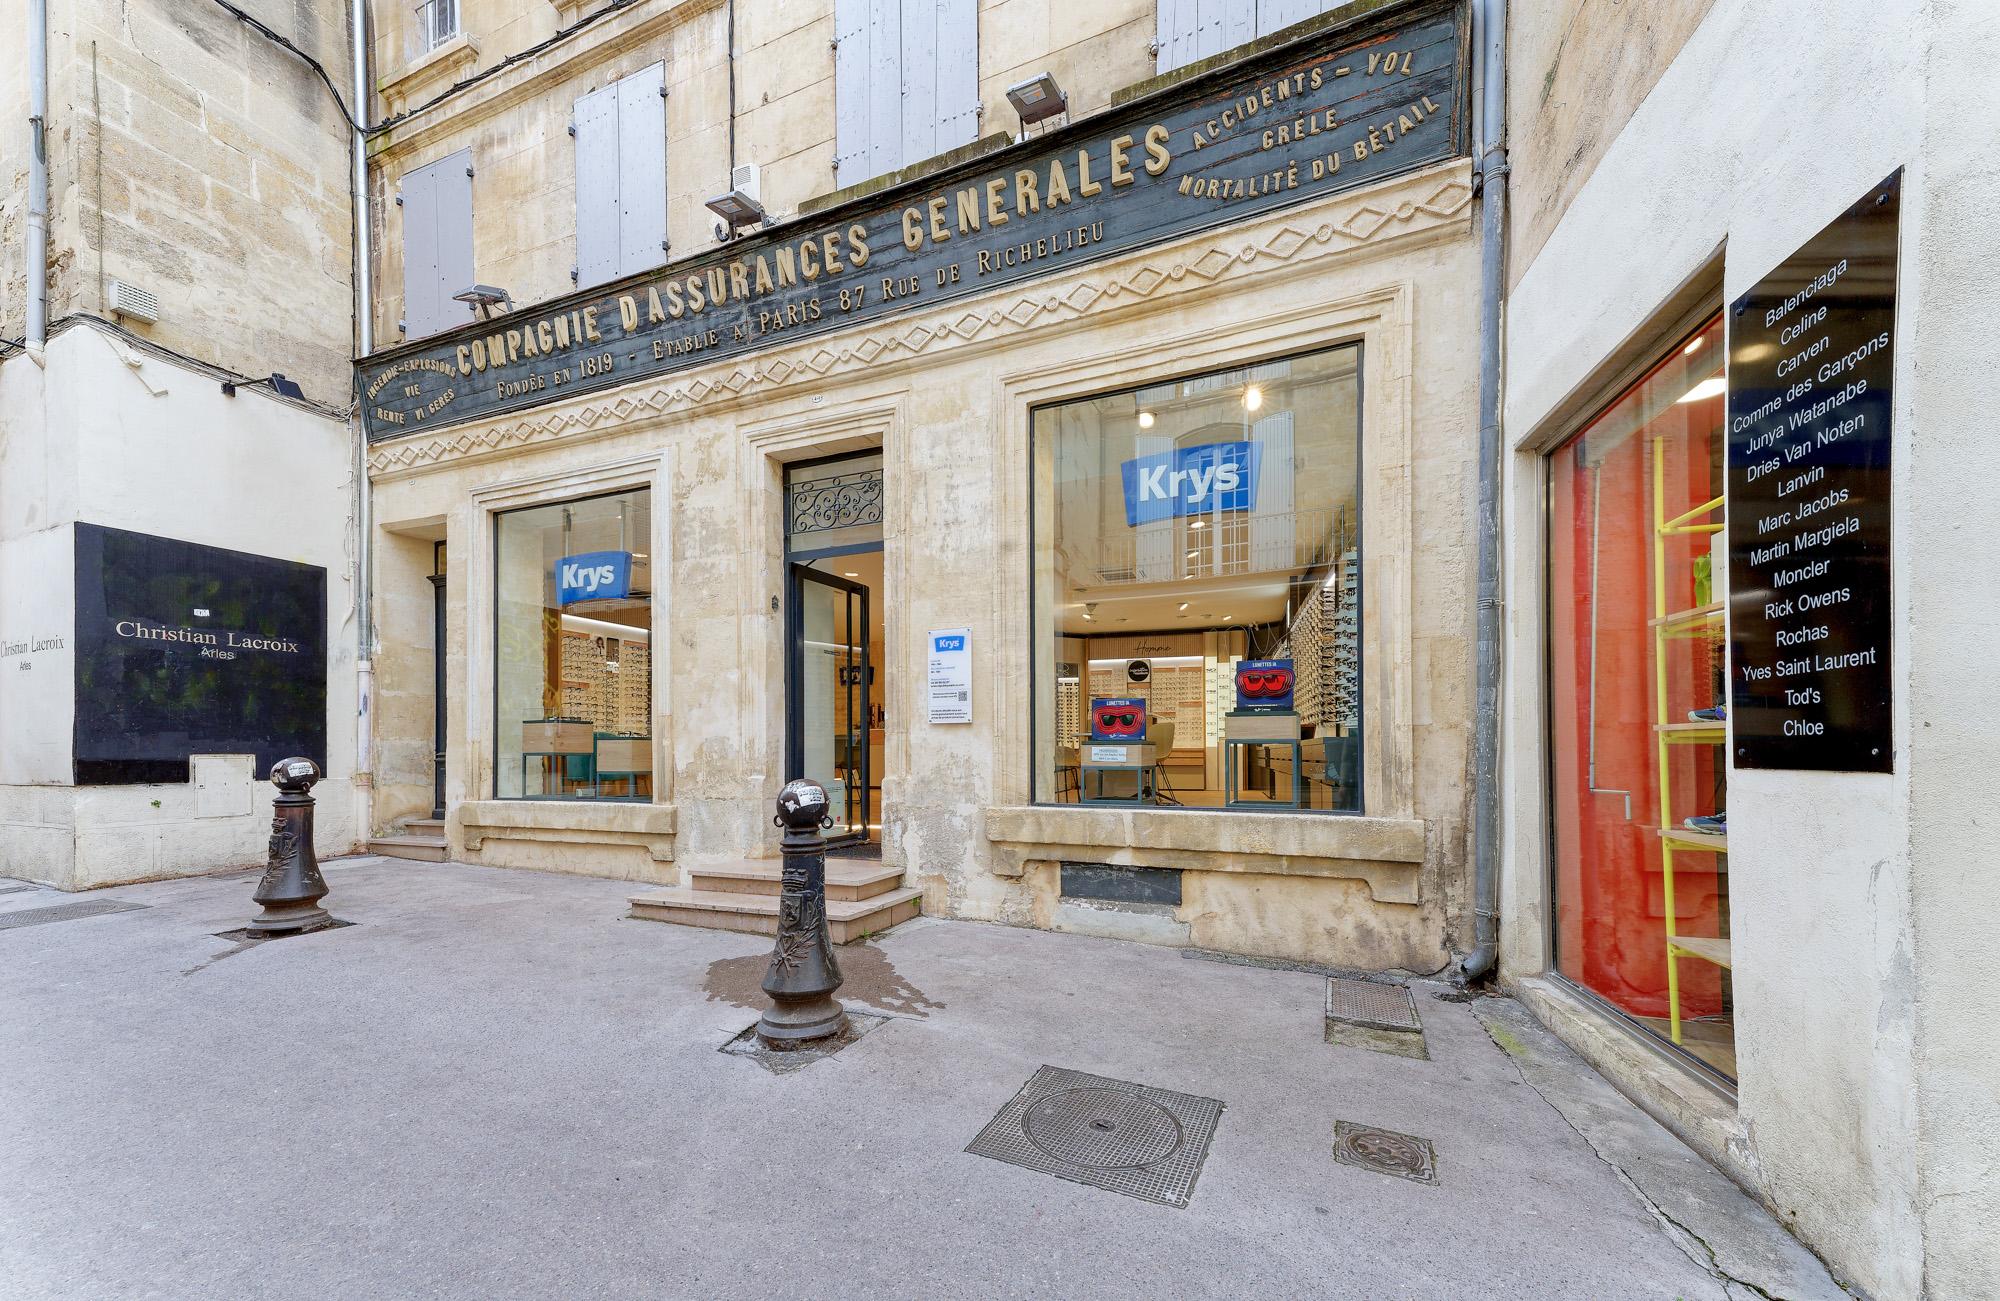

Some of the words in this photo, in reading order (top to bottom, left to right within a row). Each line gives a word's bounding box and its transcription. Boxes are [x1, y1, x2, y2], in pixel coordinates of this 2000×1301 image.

[1193, 67, 1323, 150] ACCIDENTS
[1367, 52, 1413, 76] VOL
[1312, 152, 1341, 181] DU
[456, 305, 602, 377] COMPAGNIE
[902, 124, 1171, 252] GENERALES
[554, 368, 571, 385] EN
[580, 353, 613, 379] 1819
[760, 298, 821, 334] PARIS
[840, 285, 865, 311] 87
[881, 275, 920, 301] RUE
[936, 264, 961, 286] DE
[977, 221, 1105, 275] RICHELIEU
[1765, 259, 1848, 328] Balenciaga
[1780, 305, 1828, 346] Celine
[1777, 335, 1829, 378] Carven
[404, 384, 420, 398] VIE
[1733, 397, 1782, 434] Comme
[1787, 377, 1812, 403] des
[1818, 331, 1889, 384] Garçons
[377, 407, 405, 425] RENTE
[1746, 425, 1784, 455] Junya
[1789, 378, 1867, 433] Watanabe
[1747, 459, 1780, 483] Dries
[1784, 441, 1812, 463] Van
[1817, 412, 1865, 449] Noten
[1139, 464, 1240, 504] Krys
[1778, 465, 1825, 498] Lanvin
[1758, 514, 1791, 535] Marc
[1795, 487, 1849, 520] Jacobs
[1750, 543, 1790, 567] Martin
[1795, 516, 1860, 551] Margiela
[562, 563, 615, 592] Krys
[1774, 558, 1830, 588] Moncler
[1765, 599, 1794, 620] Rick
[1798, 587, 1851, 611] Owens
[31, 634, 64, 653] Lacroix
[115, 621, 217, 645] Christian
[227, 632, 299, 653] Lacroix
[939, 639, 960, 649] Krys
[1776, 624, 1829, 647] Rochas
[200, 646, 235, 660] Arles
[1742, 664, 1771, 681] Yves
[1776, 658, 1811, 677] Saint
[1815, 647, 1876, 672] Laurent
[1785, 688, 1821, 706] Tod's
[1783, 719, 1824, 736] Chloe
